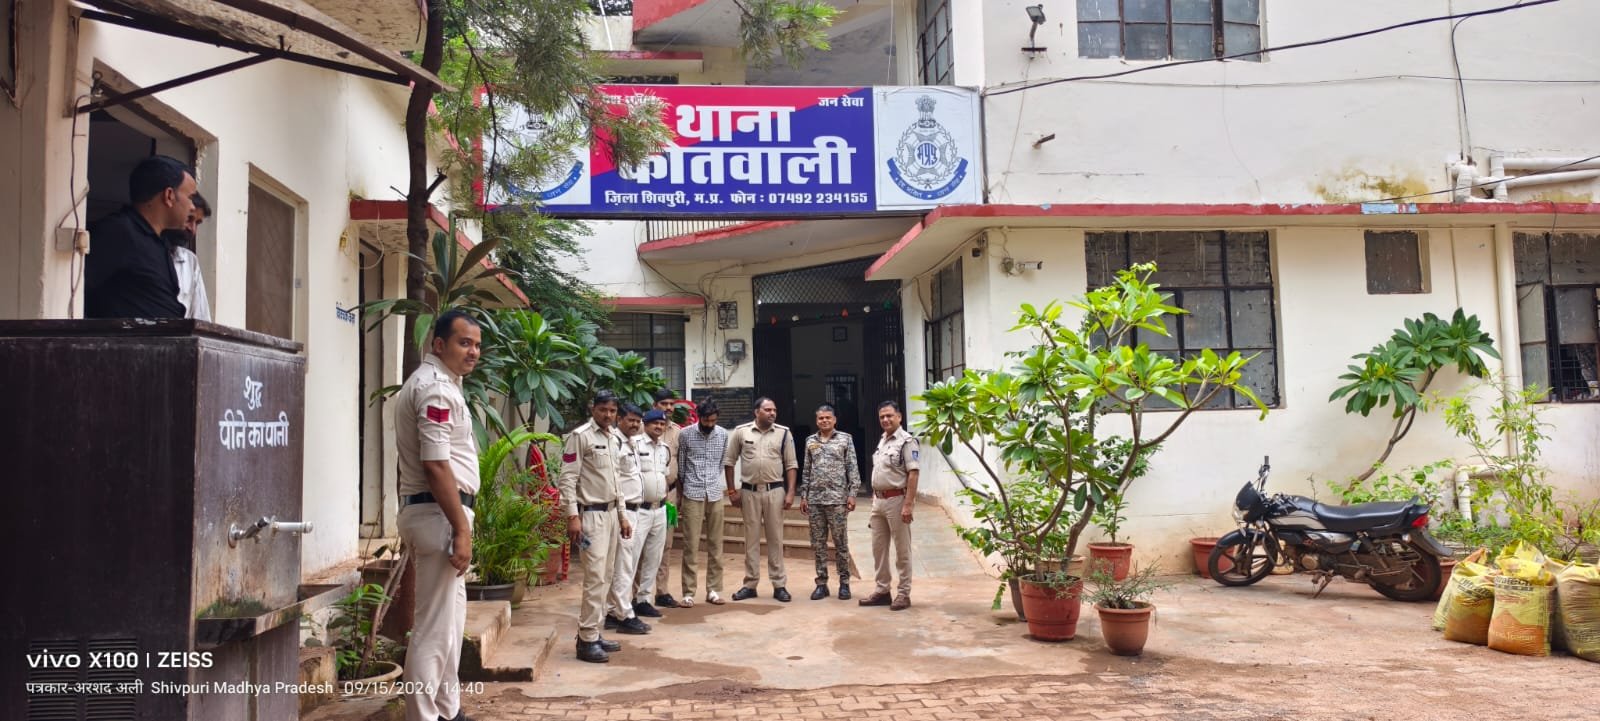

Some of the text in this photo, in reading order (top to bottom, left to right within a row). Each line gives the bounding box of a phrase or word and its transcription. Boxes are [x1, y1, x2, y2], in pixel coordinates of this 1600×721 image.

[818, 95, 864, 107] जन सेवा
[676, 104, 796, 142] थाना
[618, 136, 857, 185] कोतवाली
[641, 190, 690, 208] शिवपुरी,
[694, 193, 723, 205] म.प्र.
[730, 191, 756, 204] फोन
[768, 193, 812, 204] 07492
[816, 192, 868, 203] 234155
[218, 408, 290, 450] पीने का पानी
